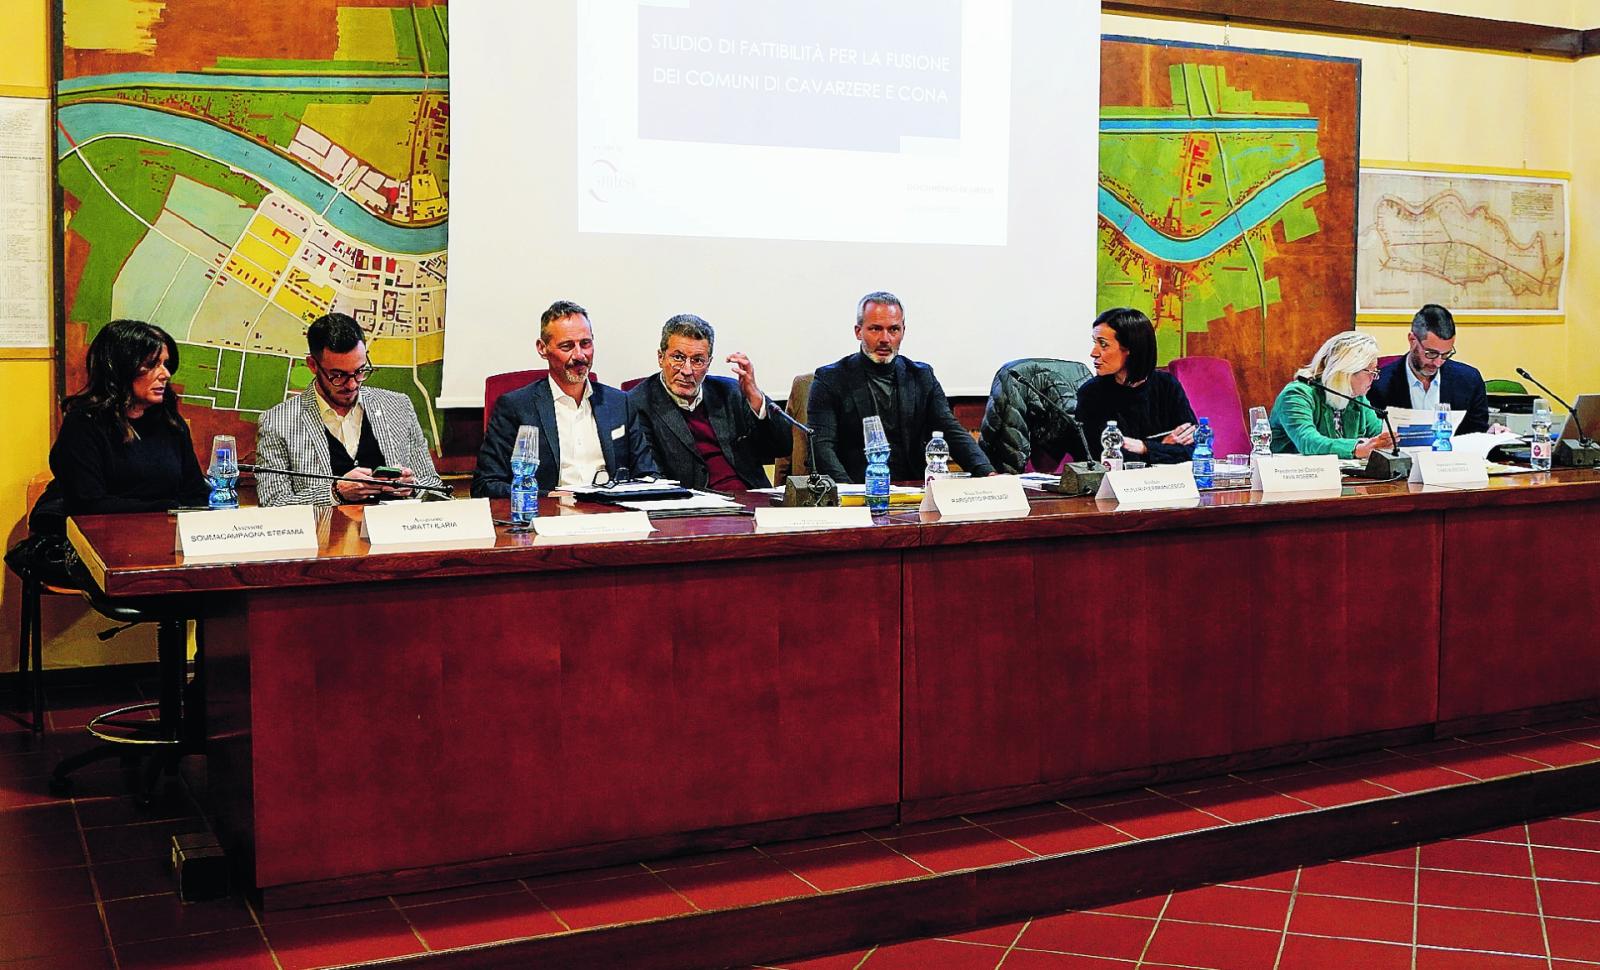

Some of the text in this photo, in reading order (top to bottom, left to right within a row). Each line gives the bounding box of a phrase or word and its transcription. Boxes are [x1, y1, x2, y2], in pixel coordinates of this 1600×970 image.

[651, 32, 951, 72] STUDIO DI FATTIBILITÀ PER LA FUSIONE
[652, 67, 949, 104] DEI COMUNI DI CAVARZERE E CONA
